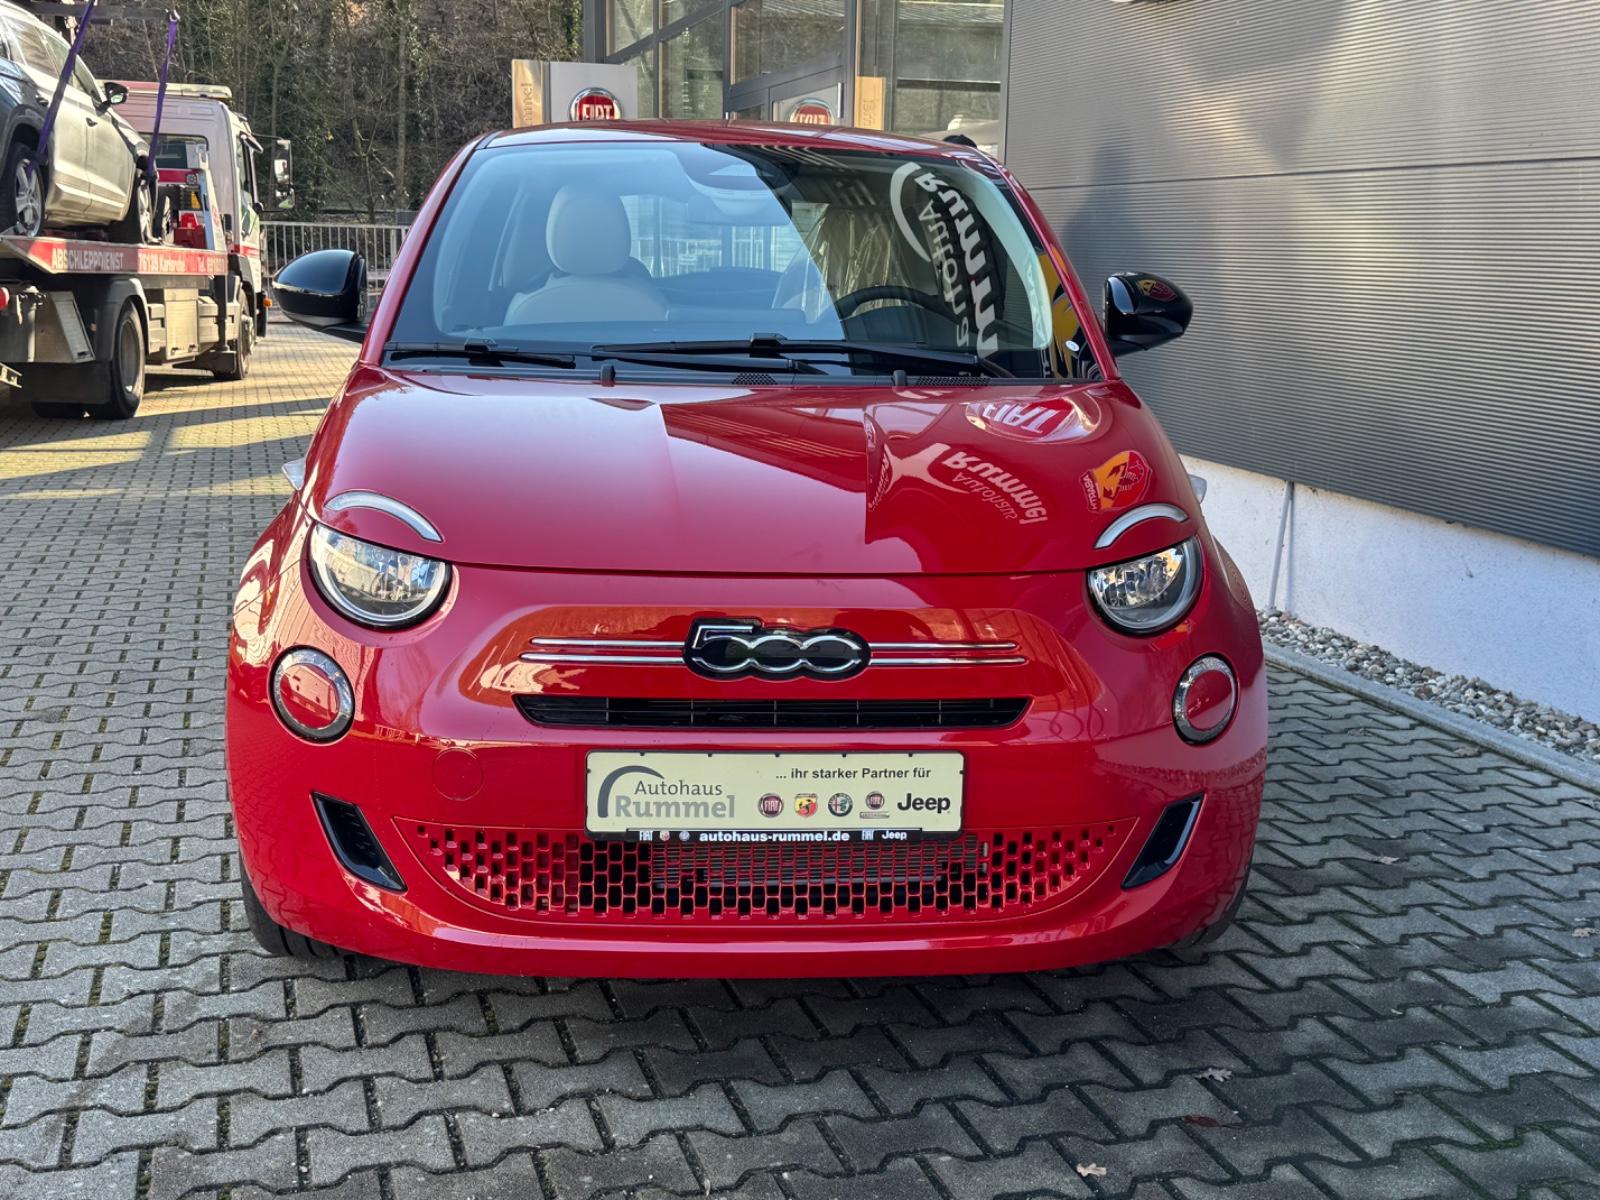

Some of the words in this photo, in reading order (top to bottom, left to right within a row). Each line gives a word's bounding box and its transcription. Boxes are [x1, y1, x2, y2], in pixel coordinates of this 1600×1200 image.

[582, 104, 613, 120] FIAT
[52, 248, 124, 270] ABSCHLEPPDIENST
[691, 625, 862, 673] 500
[791, 768, 808, 778] ihr
[812, 768, 857, 778] starker
[862, 767, 909, 778] Partner
[913, 767, 931, 778] für
[634, 780, 722, 795] Autohaus
[615, 795, 735, 818] Rummel
[897, 793, 950, 814] Jeep
[699, 830, 850, 842] autohaus-rummel.de
[881, 830, 907, 840] Jeep
